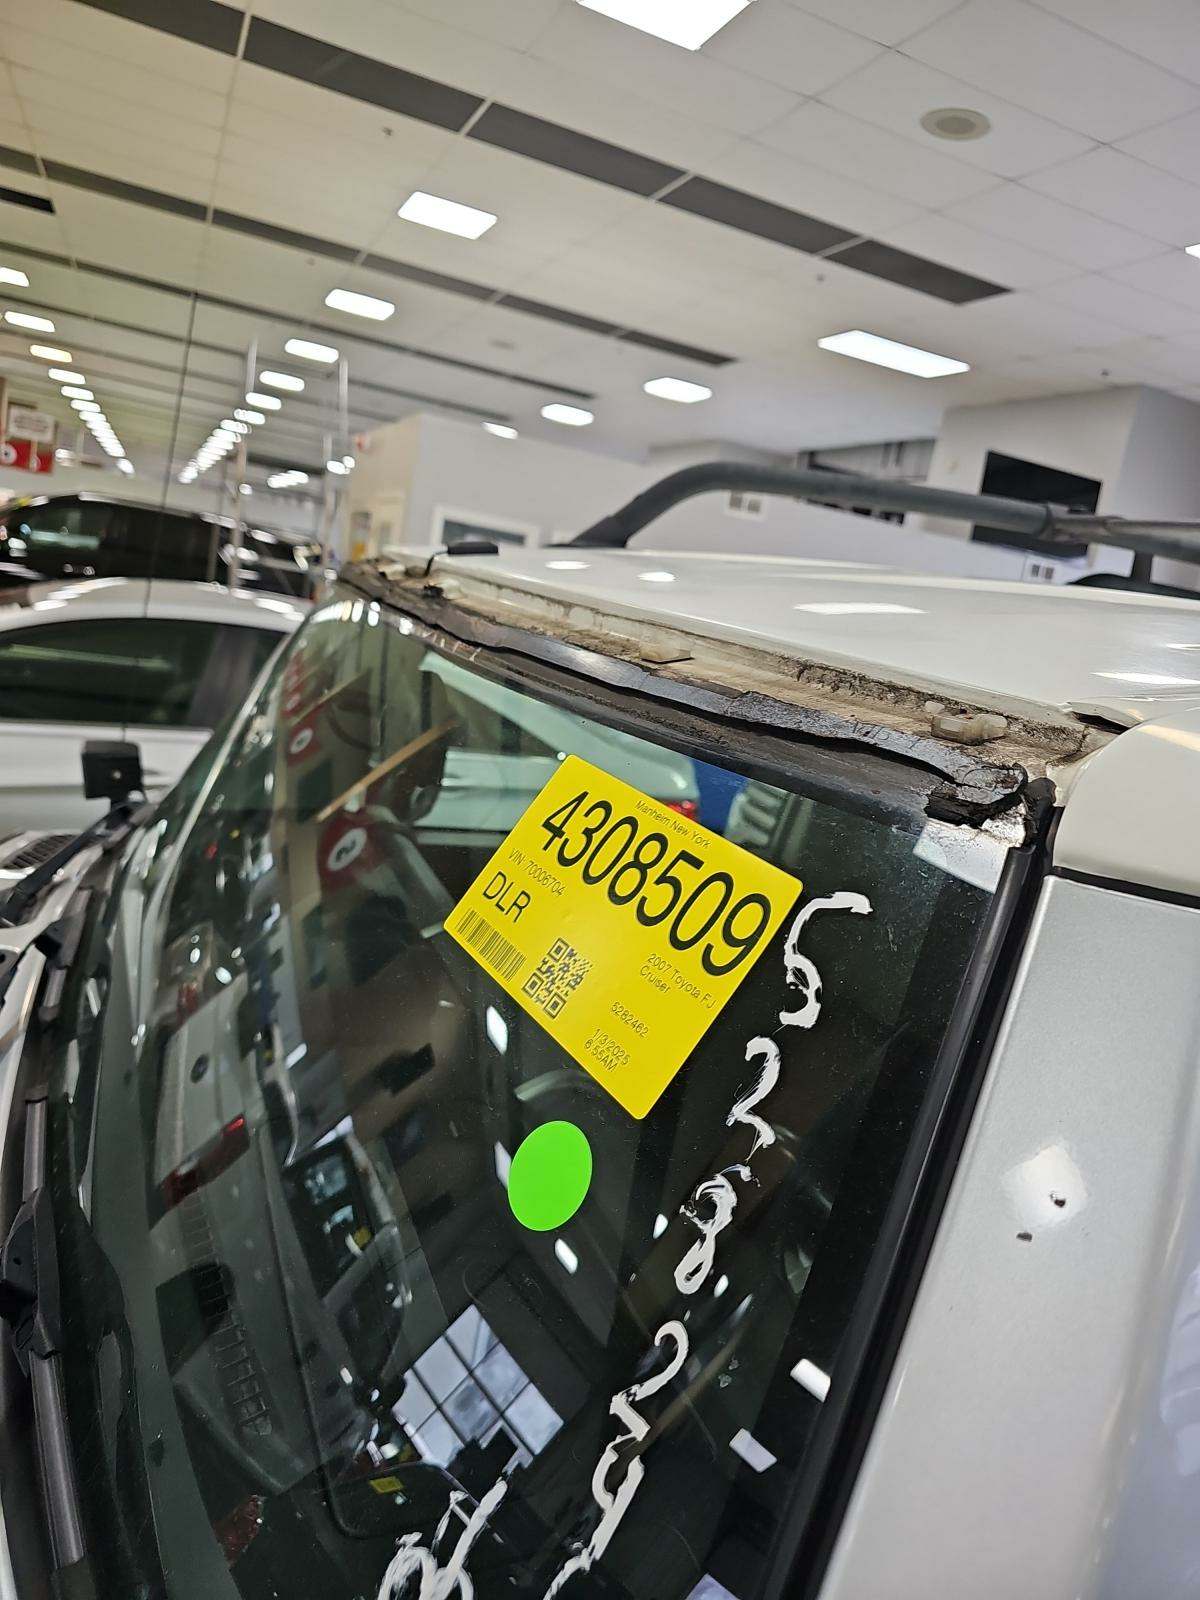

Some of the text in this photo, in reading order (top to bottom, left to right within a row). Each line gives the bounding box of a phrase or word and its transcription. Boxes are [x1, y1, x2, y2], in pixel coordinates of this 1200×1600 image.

[635, 800, 711, 849] Manheim New York
[482, 870, 531, 923] DLR
[541, 790, 772, 977] 4308509
[640, 965, 671, 993] Cruiser
[647, 953, 717, 1009] 2007 Toyota FJ
